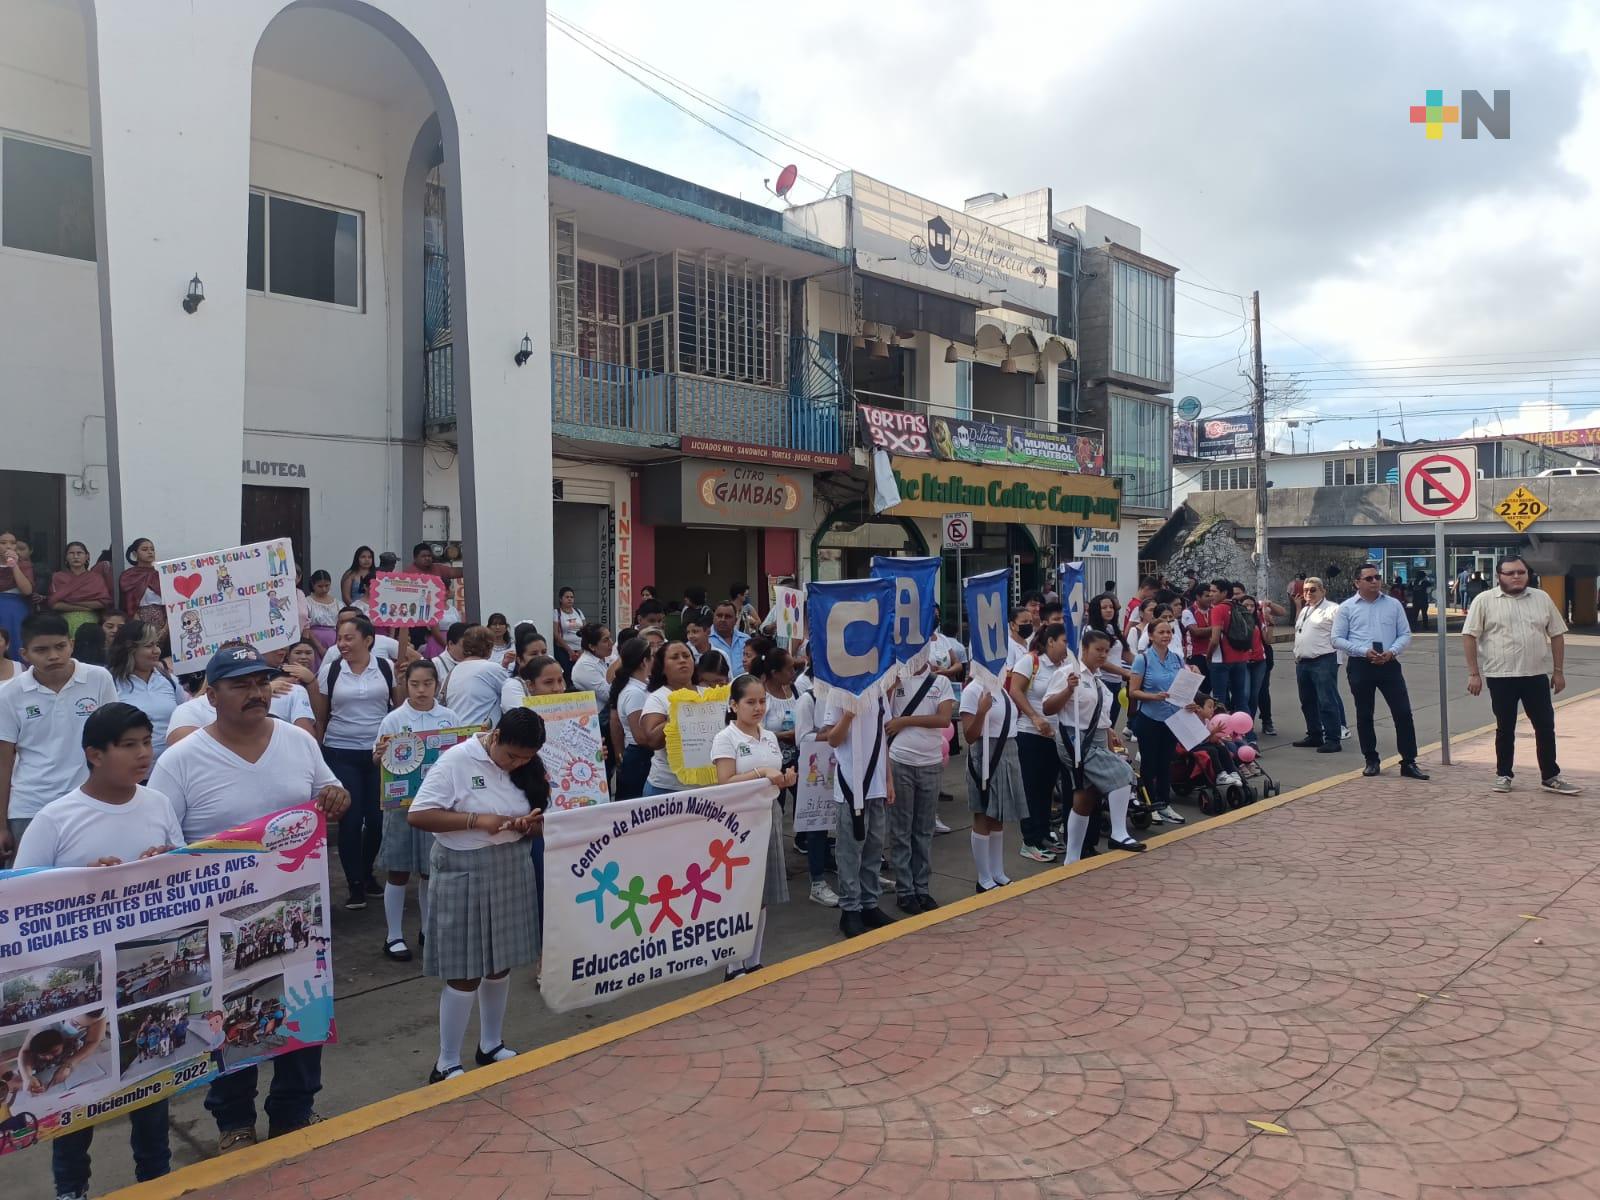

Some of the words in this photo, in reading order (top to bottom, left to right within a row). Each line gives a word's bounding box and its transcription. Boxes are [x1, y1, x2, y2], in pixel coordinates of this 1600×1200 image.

[861, 406, 926, 434] TORTAS
[1024, 439, 1073, 453] MUNDIAL
[691, 441, 721, 452] LICUADOS
[722, 444, 733, 453] MIX
[737, 447, 767, 457] SANDWICH
[772, 450, 791, 460] TORTAS
[795, 454, 810, 463] JUGOS
[814, 456, 838, 465] COCTELES
[734, 467, 764, 481] CITRO
[715, 482, 783, 506] GAMBAS
[893, 470, 920, 500] he
[922, 473, 986, 506] Italian
[988, 480, 1046, 510] Coffee
[1048, 485, 1119, 522] Company
[1501, 502, 1541, 516] 2.20
[161, 562, 187, 575] TODOS
[191, 556, 219, 569] SOMOS
[178, 592, 223, 611] TENEMOS
[237, 578, 284, 596] QUEREMOS
[895, 577, 924, 645] A
[826, 600, 879, 677] C
[977, 592, 1008, 661] M
[571, 834, 610, 878] Centro
[613, 818, 629, 839] de
[630, 800, 683, 828] Atención
[685, 796, 726, 824] Múltiple
[724, 812, 739, 837] No.
[739, 829, 751, 844] 4
[15, 893, 96, 921] PERSONAS
[102, 889, 118, 903] AL
[123, 878, 162, 898] IGUAL
[166, 869, 192, 888] QUE
[196, 861, 220, 881] LAS
[224, 854, 259, 875] AVES,
[20, 917, 51, 938] SON
[56, 897, 141, 928] DIFERENTES
[144, 889, 163, 906] EN
[167, 884, 186, 901] SU
[190, 875, 231, 897] VUELO
[27, 925, 90, 951] IGUALES
[93, 919, 112, 936] EN
[116, 914, 136, 931] SU
[139, 898, 201, 925] DERECHO
[205, 894, 215, 909] A
[217, 878, 259, 905] VOLÁR.
[571, 937, 667, 981] Educación
[671, 911, 753, 951] ESPECIAL
[594, 978, 623, 996] Mtz
[627, 971, 645, 987] de
[649, 966, 663, 981] la
[666, 953, 708, 974] Torre,
[711, 946, 736, 961] Ver.
[60, 1111, 72, 1126] 3
[87, 1081, 162, 1118] Diciembre
[173, 1060, 208, 1087] 2022
